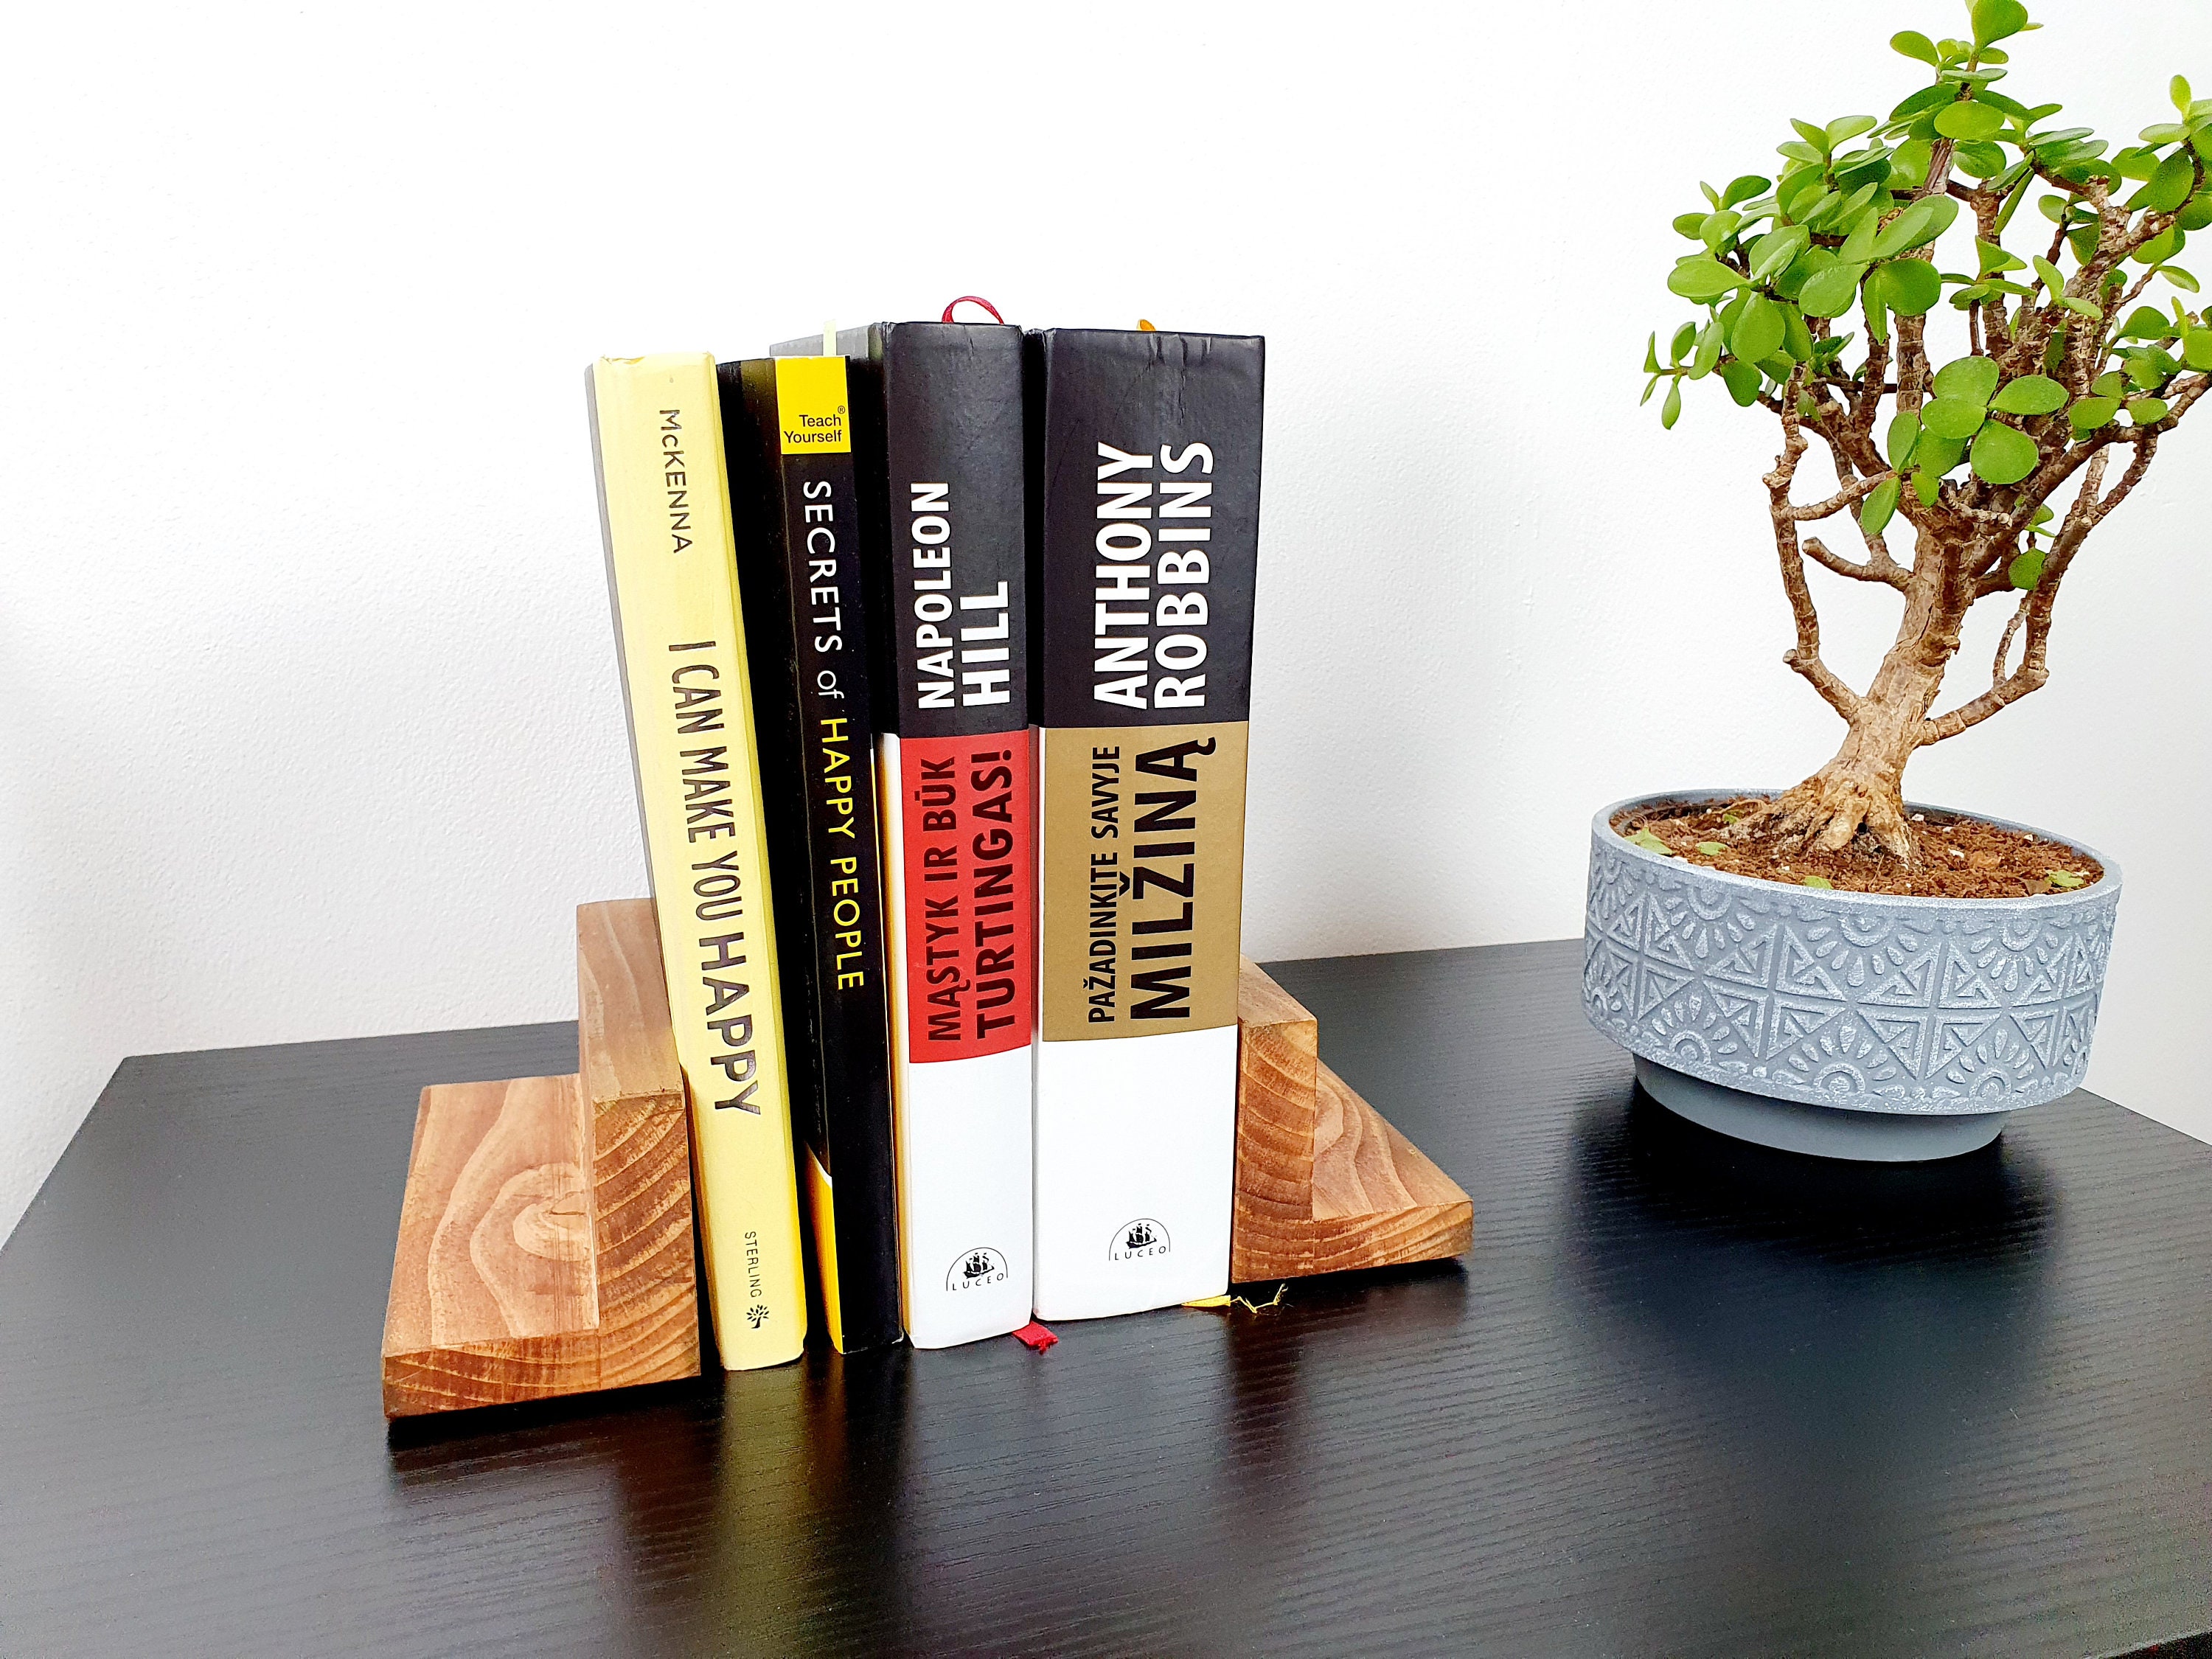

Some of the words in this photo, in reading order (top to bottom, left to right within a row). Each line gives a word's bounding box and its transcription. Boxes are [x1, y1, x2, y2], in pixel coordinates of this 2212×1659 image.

[784, 429, 844, 444] Yourself
[799, 414, 843, 428] Teach
[659, 408, 693, 554] McKENNA
[803, 481, 843, 653] SECRETS
[911, 482, 956, 709] NAPOLEON
[1093, 441, 1154, 710] ANTHONY
[1153, 442, 1214, 709] ROBBINS
[668, 640, 717, 653] I
[671, 664, 726, 734] CAN
[817, 670, 844, 699] of
[959, 580, 1011, 708] HILL
[680, 745, 736, 844] MAKE
[820, 717, 856, 839] HAPPY
[914, 756, 957, 832] BŪK
[1090, 745, 1121, 839] SAVYJE
[691, 849, 743, 922] YOU
[924, 845, 958, 882] IR
[970, 749, 1016, 1040] TURTINGAS!
[1119, 737, 1217, 1020] MILŽINĄ
[830, 856, 864, 990] PEOPLE
[925, 896, 971, 1042] MĄSTYK
[1083, 852, 1119, 1023] PAŽADINKITE
[698, 931, 761, 1116] HAPPY
[745, 1231, 762, 1298] STERLING
[952, 1273, 1004, 1291] LUCEO
[1114, 1245, 1166, 1261] LUCEO
